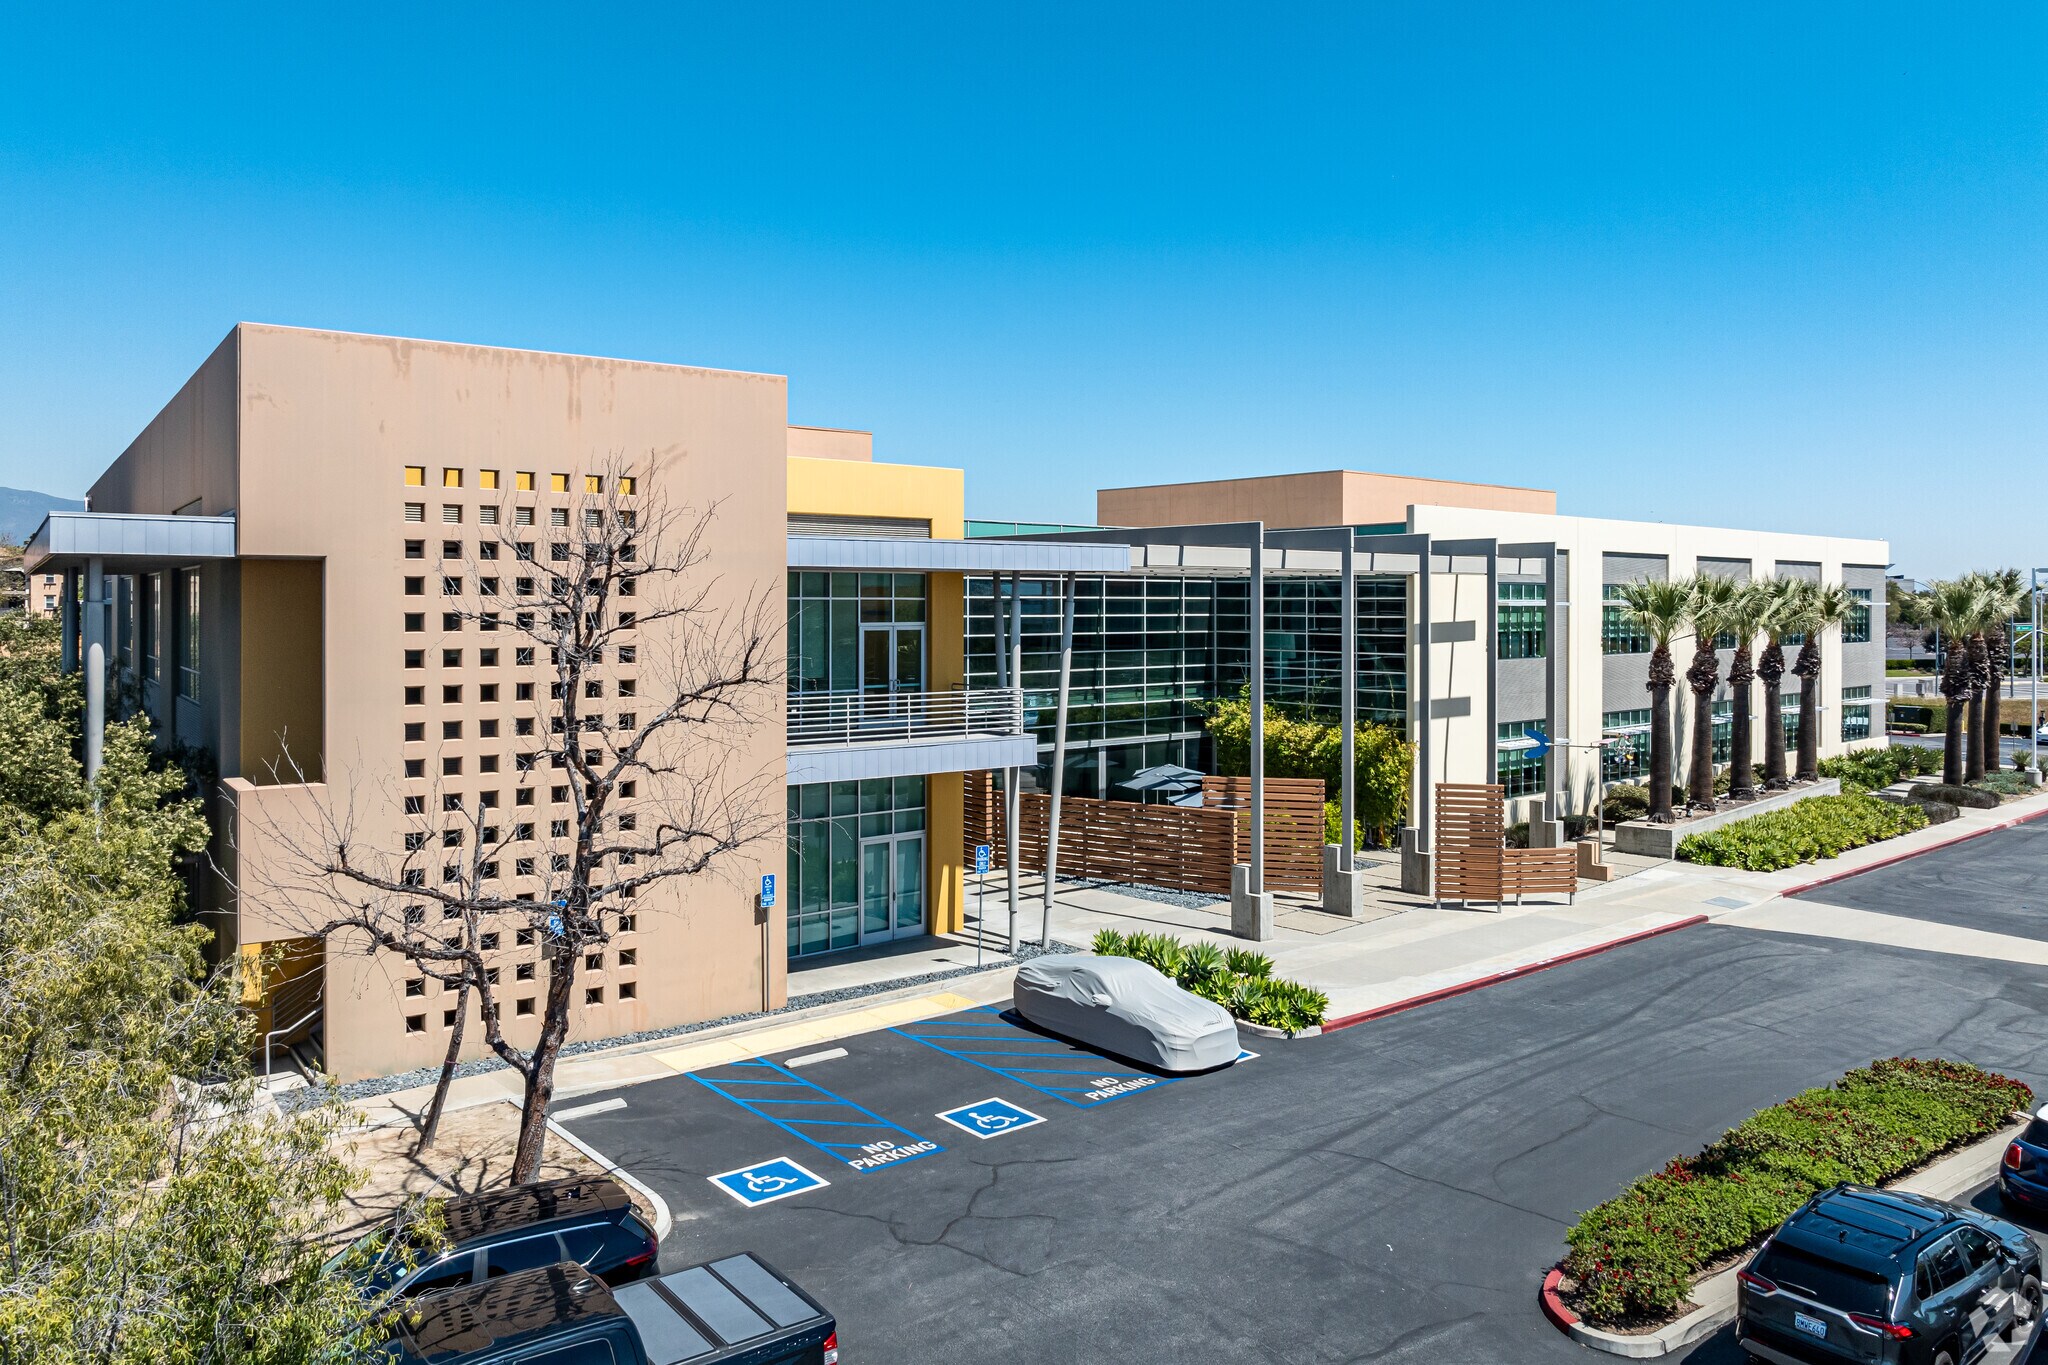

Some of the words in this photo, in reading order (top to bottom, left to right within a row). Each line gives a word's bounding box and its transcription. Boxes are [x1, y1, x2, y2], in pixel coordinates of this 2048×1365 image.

[1084, 1077, 1156, 1101] PARKING
[1090, 1077, 1119, 1088] NO
[847, 1141, 938, 1170] PARKING
[861, 1140, 895, 1154] NO
